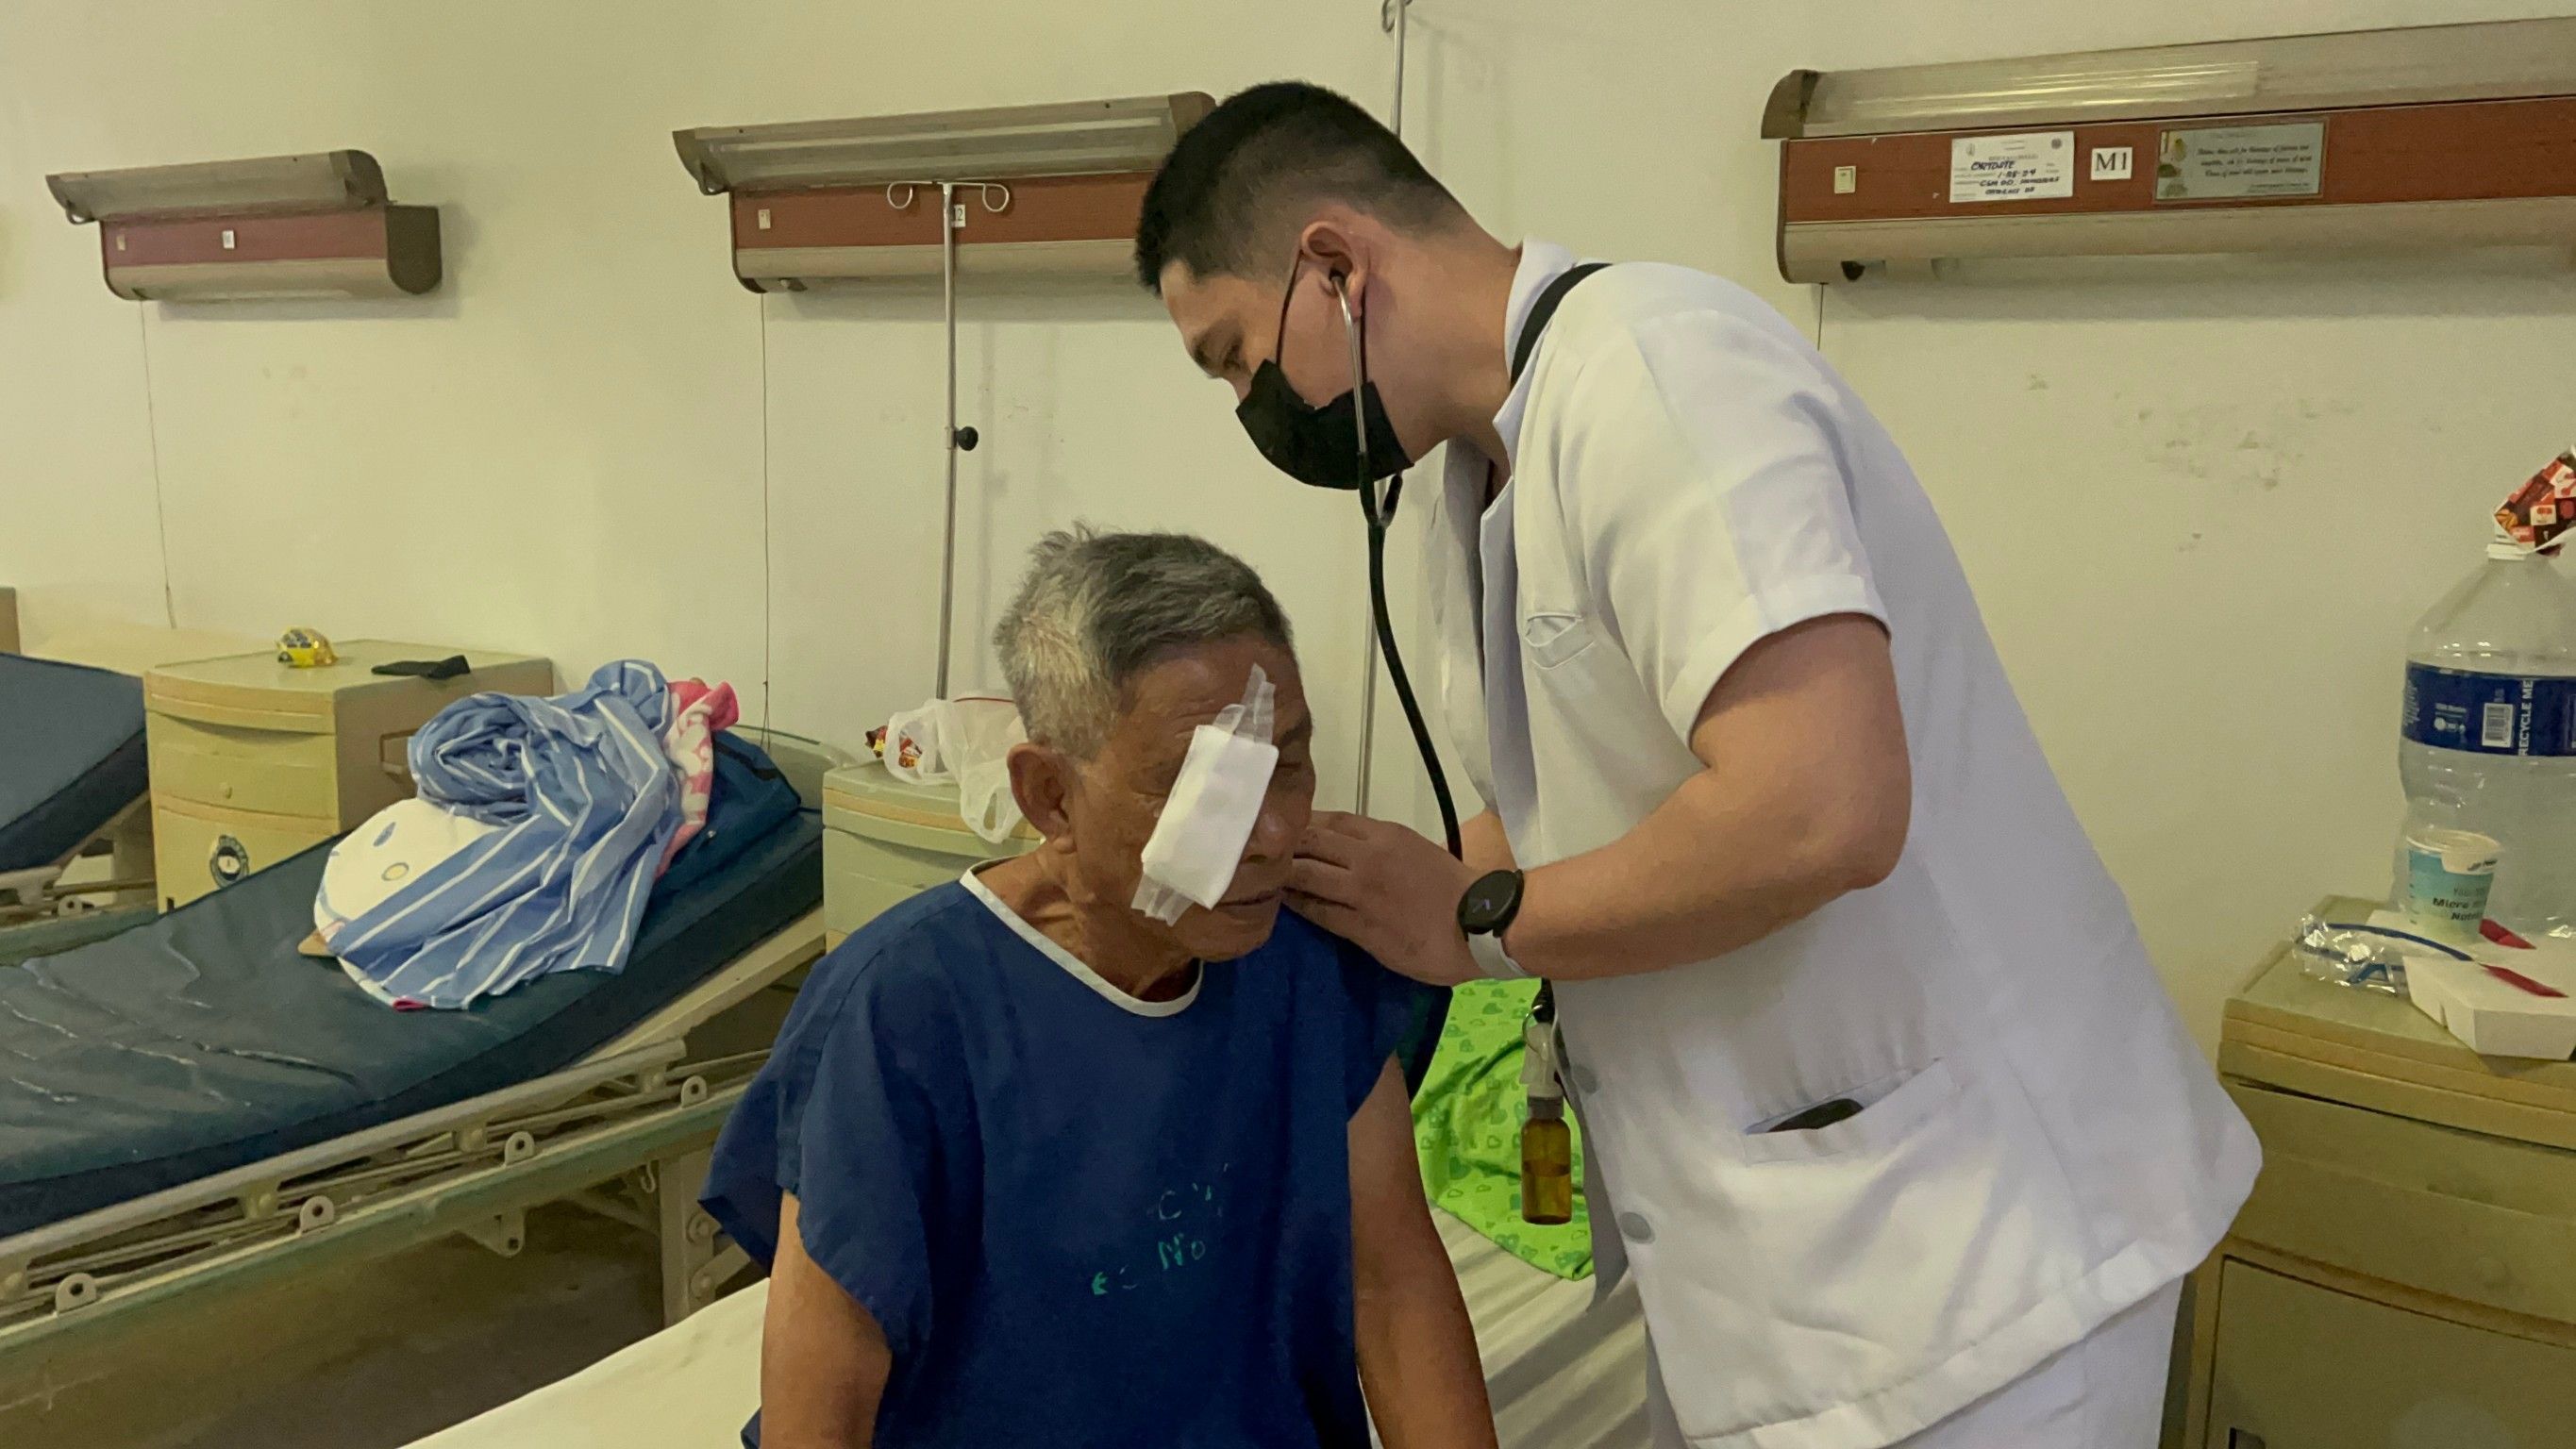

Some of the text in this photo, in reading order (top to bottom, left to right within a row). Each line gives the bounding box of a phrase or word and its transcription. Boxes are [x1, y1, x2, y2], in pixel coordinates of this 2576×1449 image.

[2096, 152, 2127, 171] M1
[2518, 678, 2534, 756] RECYCLE ME
